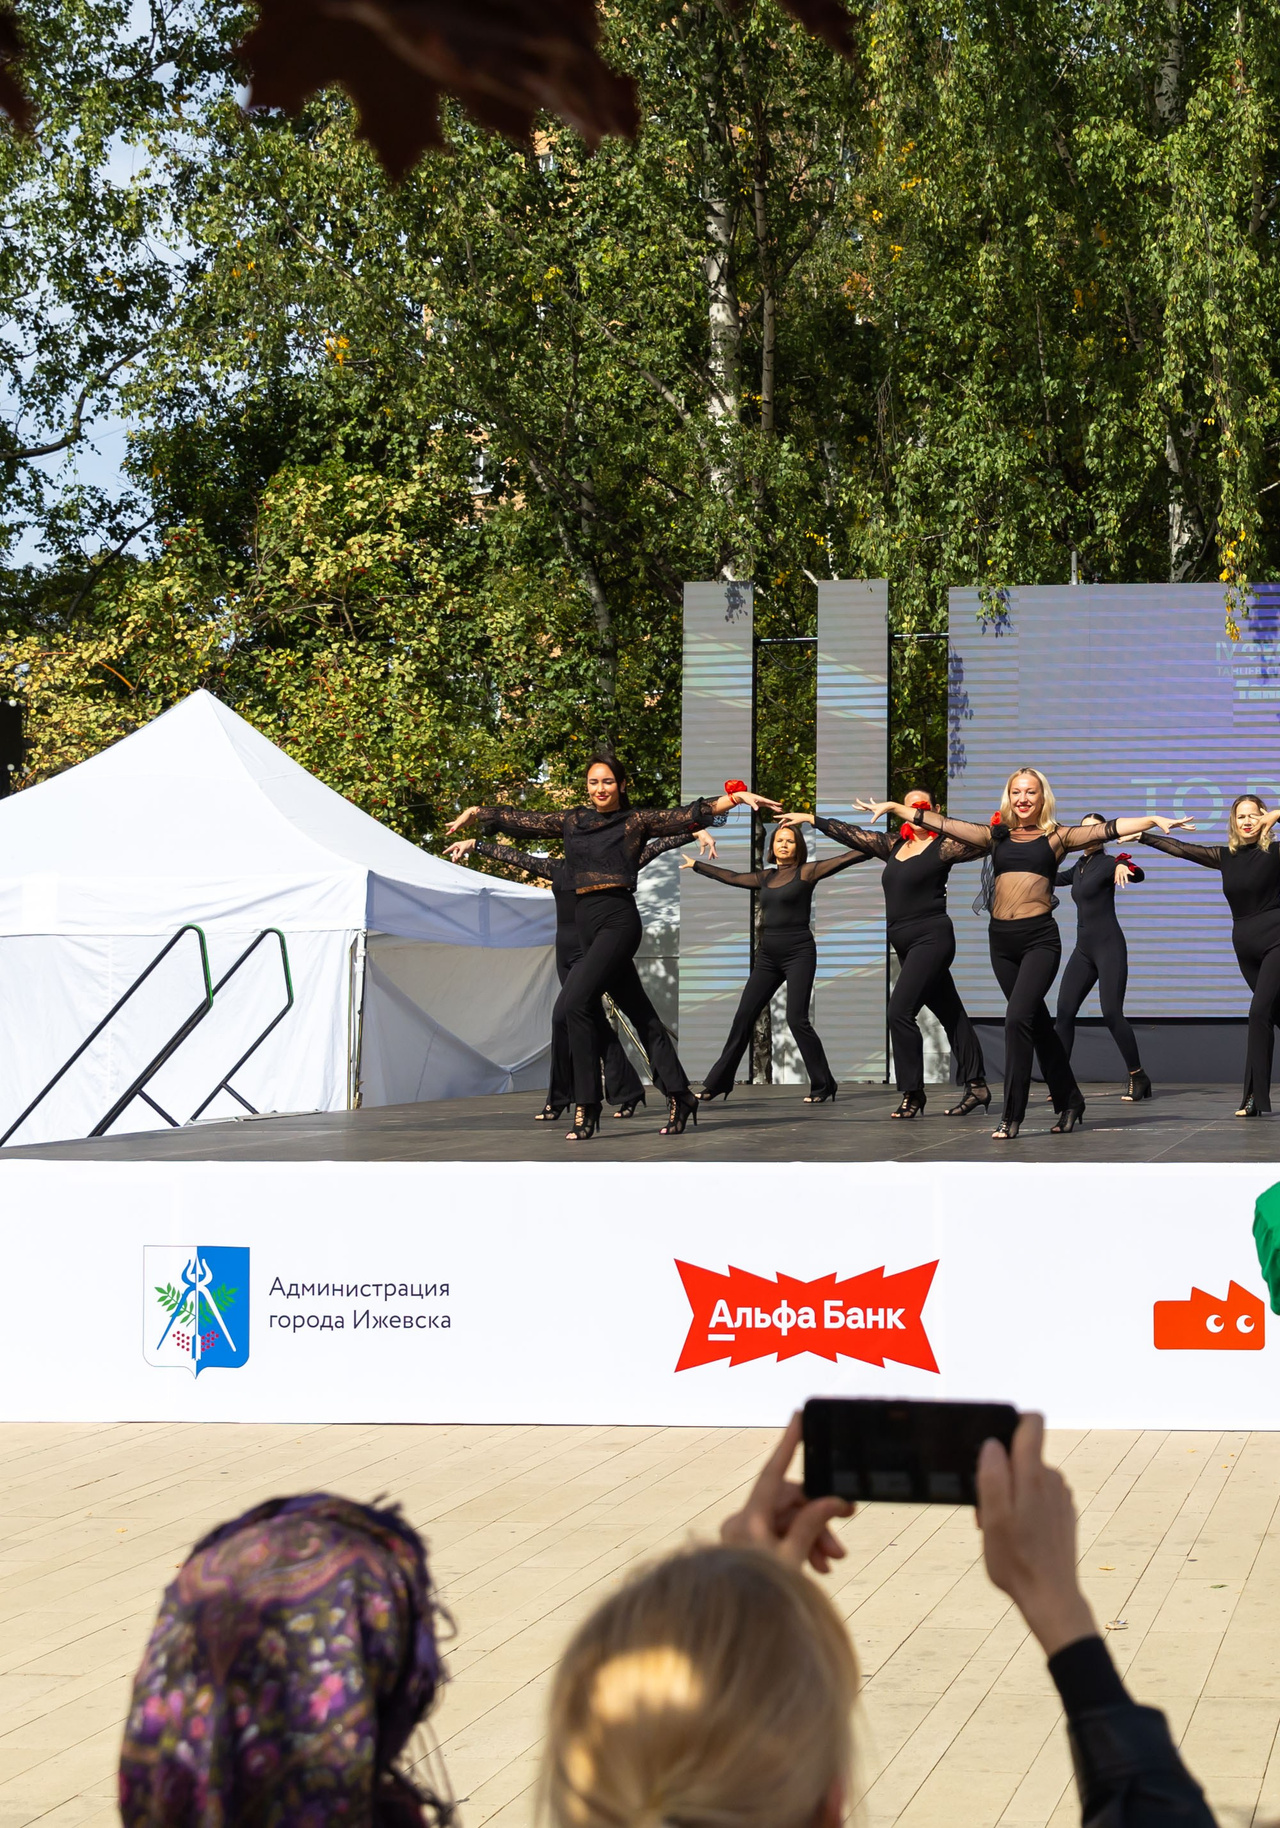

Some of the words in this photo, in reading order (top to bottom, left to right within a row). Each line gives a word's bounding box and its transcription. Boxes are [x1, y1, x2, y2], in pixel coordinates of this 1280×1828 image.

[1131, 777, 1224, 831] TO
[269, 1276, 450, 1302] Администрация
[269, 1313, 345, 1334] города
[353, 1309, 451, 1331] Ижевска
[708, 1299, 816, 1337] Альфа
[823, 1299, 906, 1330] Банк
